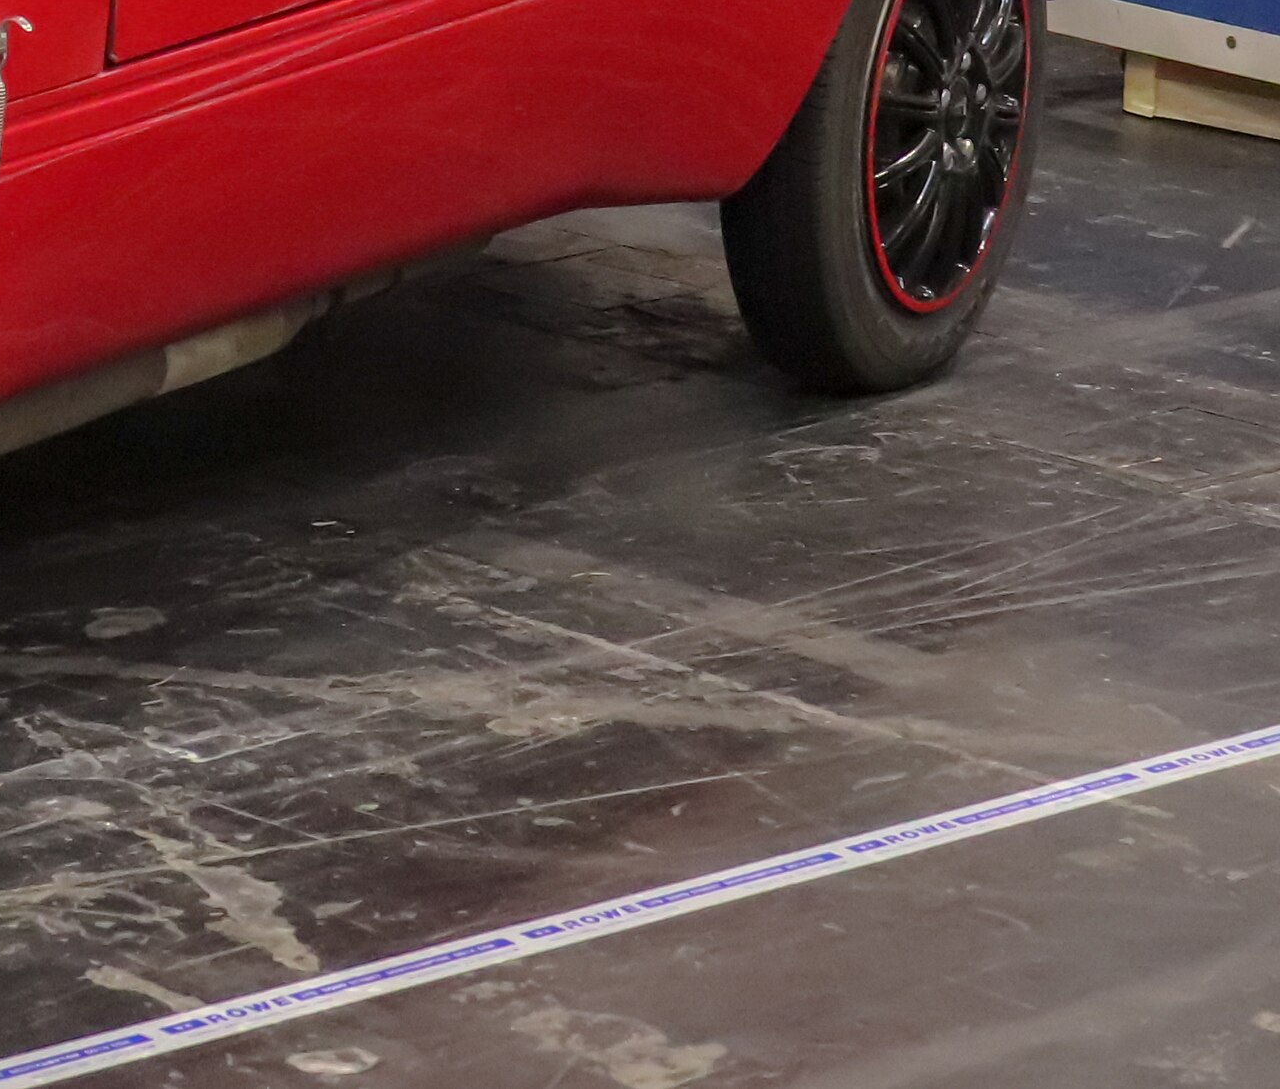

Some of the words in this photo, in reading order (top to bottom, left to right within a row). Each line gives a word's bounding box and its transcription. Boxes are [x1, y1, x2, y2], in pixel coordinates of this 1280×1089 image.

[1175, 744, 1245, 767] ROWE
[882, 820, 957, 844] ROWE
[561, 904, 641, 930] ROWE
[205, 995, 293, 1024] ROWE
